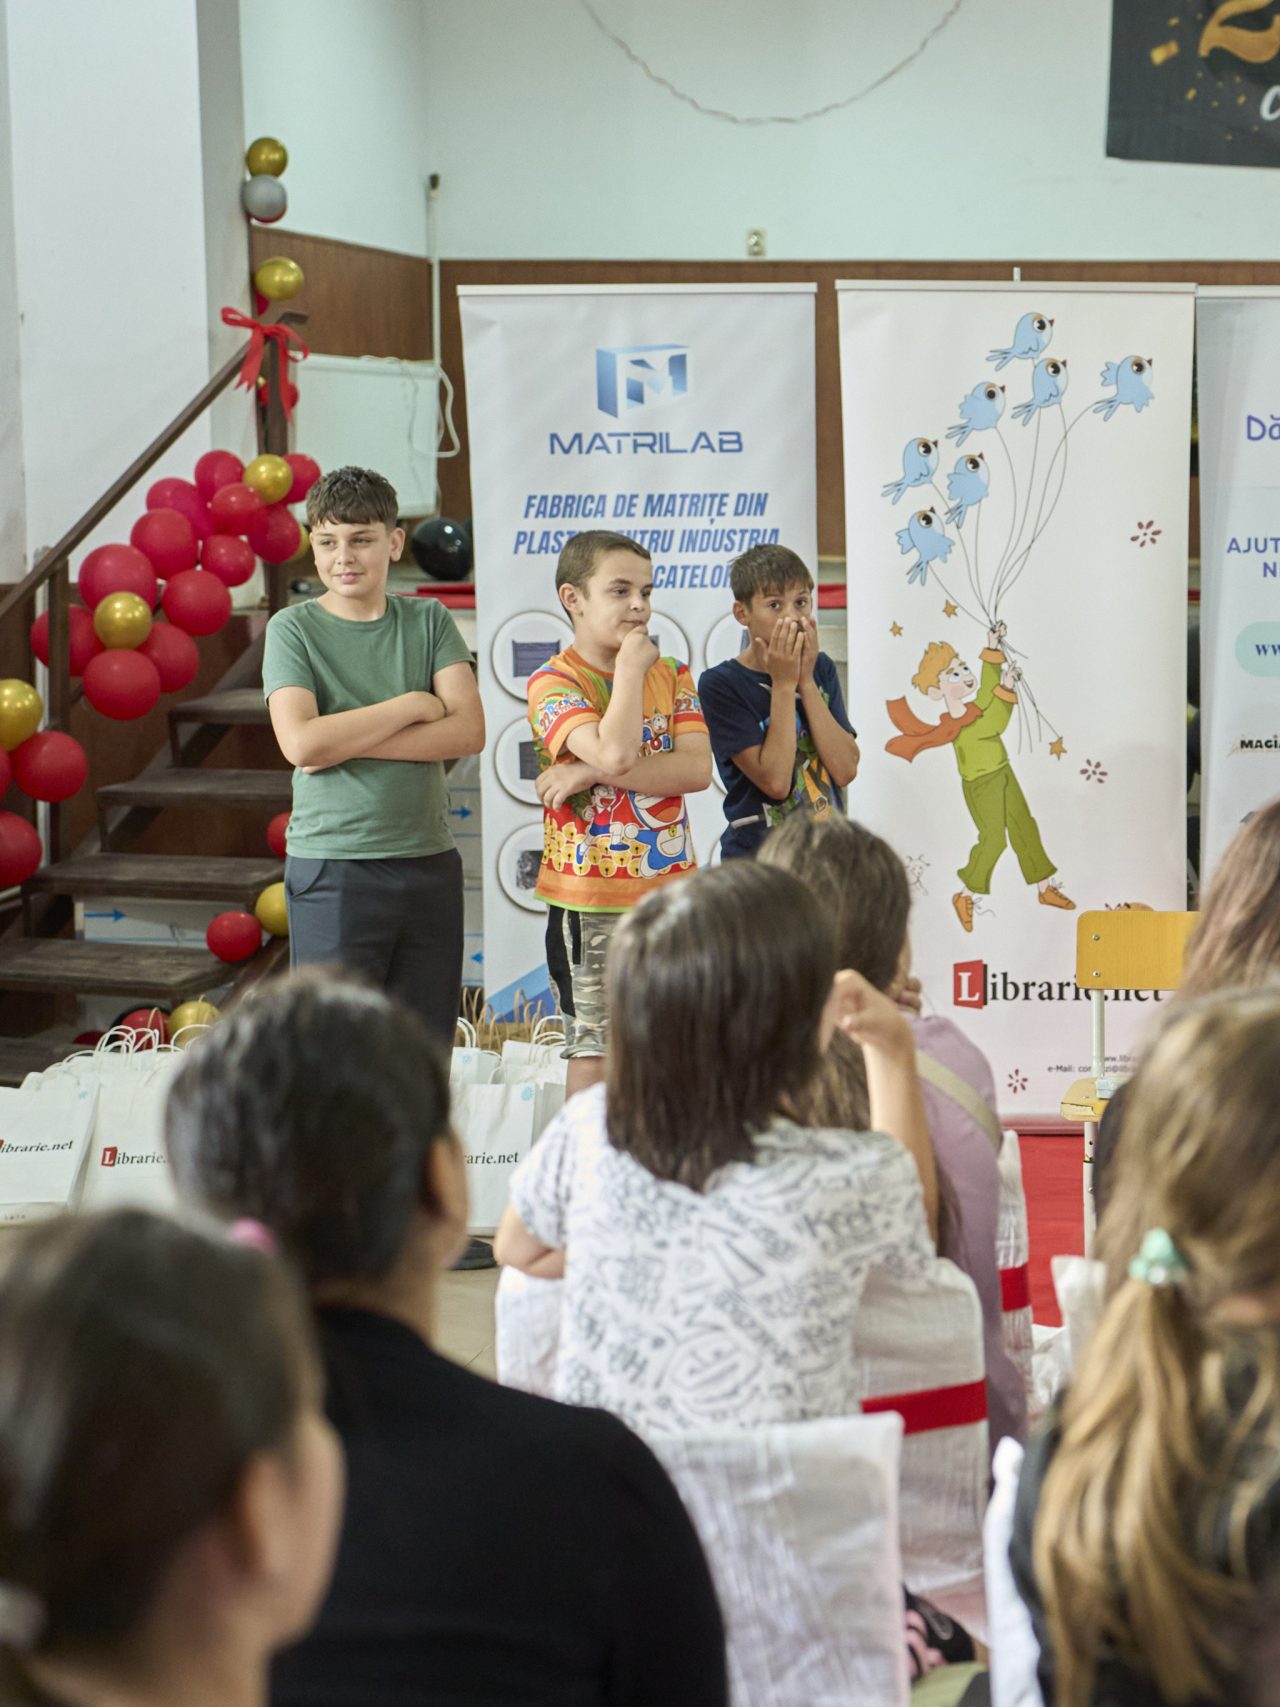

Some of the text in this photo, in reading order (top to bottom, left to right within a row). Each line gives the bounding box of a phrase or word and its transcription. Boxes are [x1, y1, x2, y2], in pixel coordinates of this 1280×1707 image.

[549, 431, 744, 455] MATRILAB
[523, 493, 768, 525] FABRICA DE MATRIȚE DIN
[679, 528, 780, 553] INDUSTRIA
[0, 1140, 73, 1153] ibrarie.net
[101, 1146, 167, 1167] Librarie.
[464, 1152, 519, 1164] arie.net
